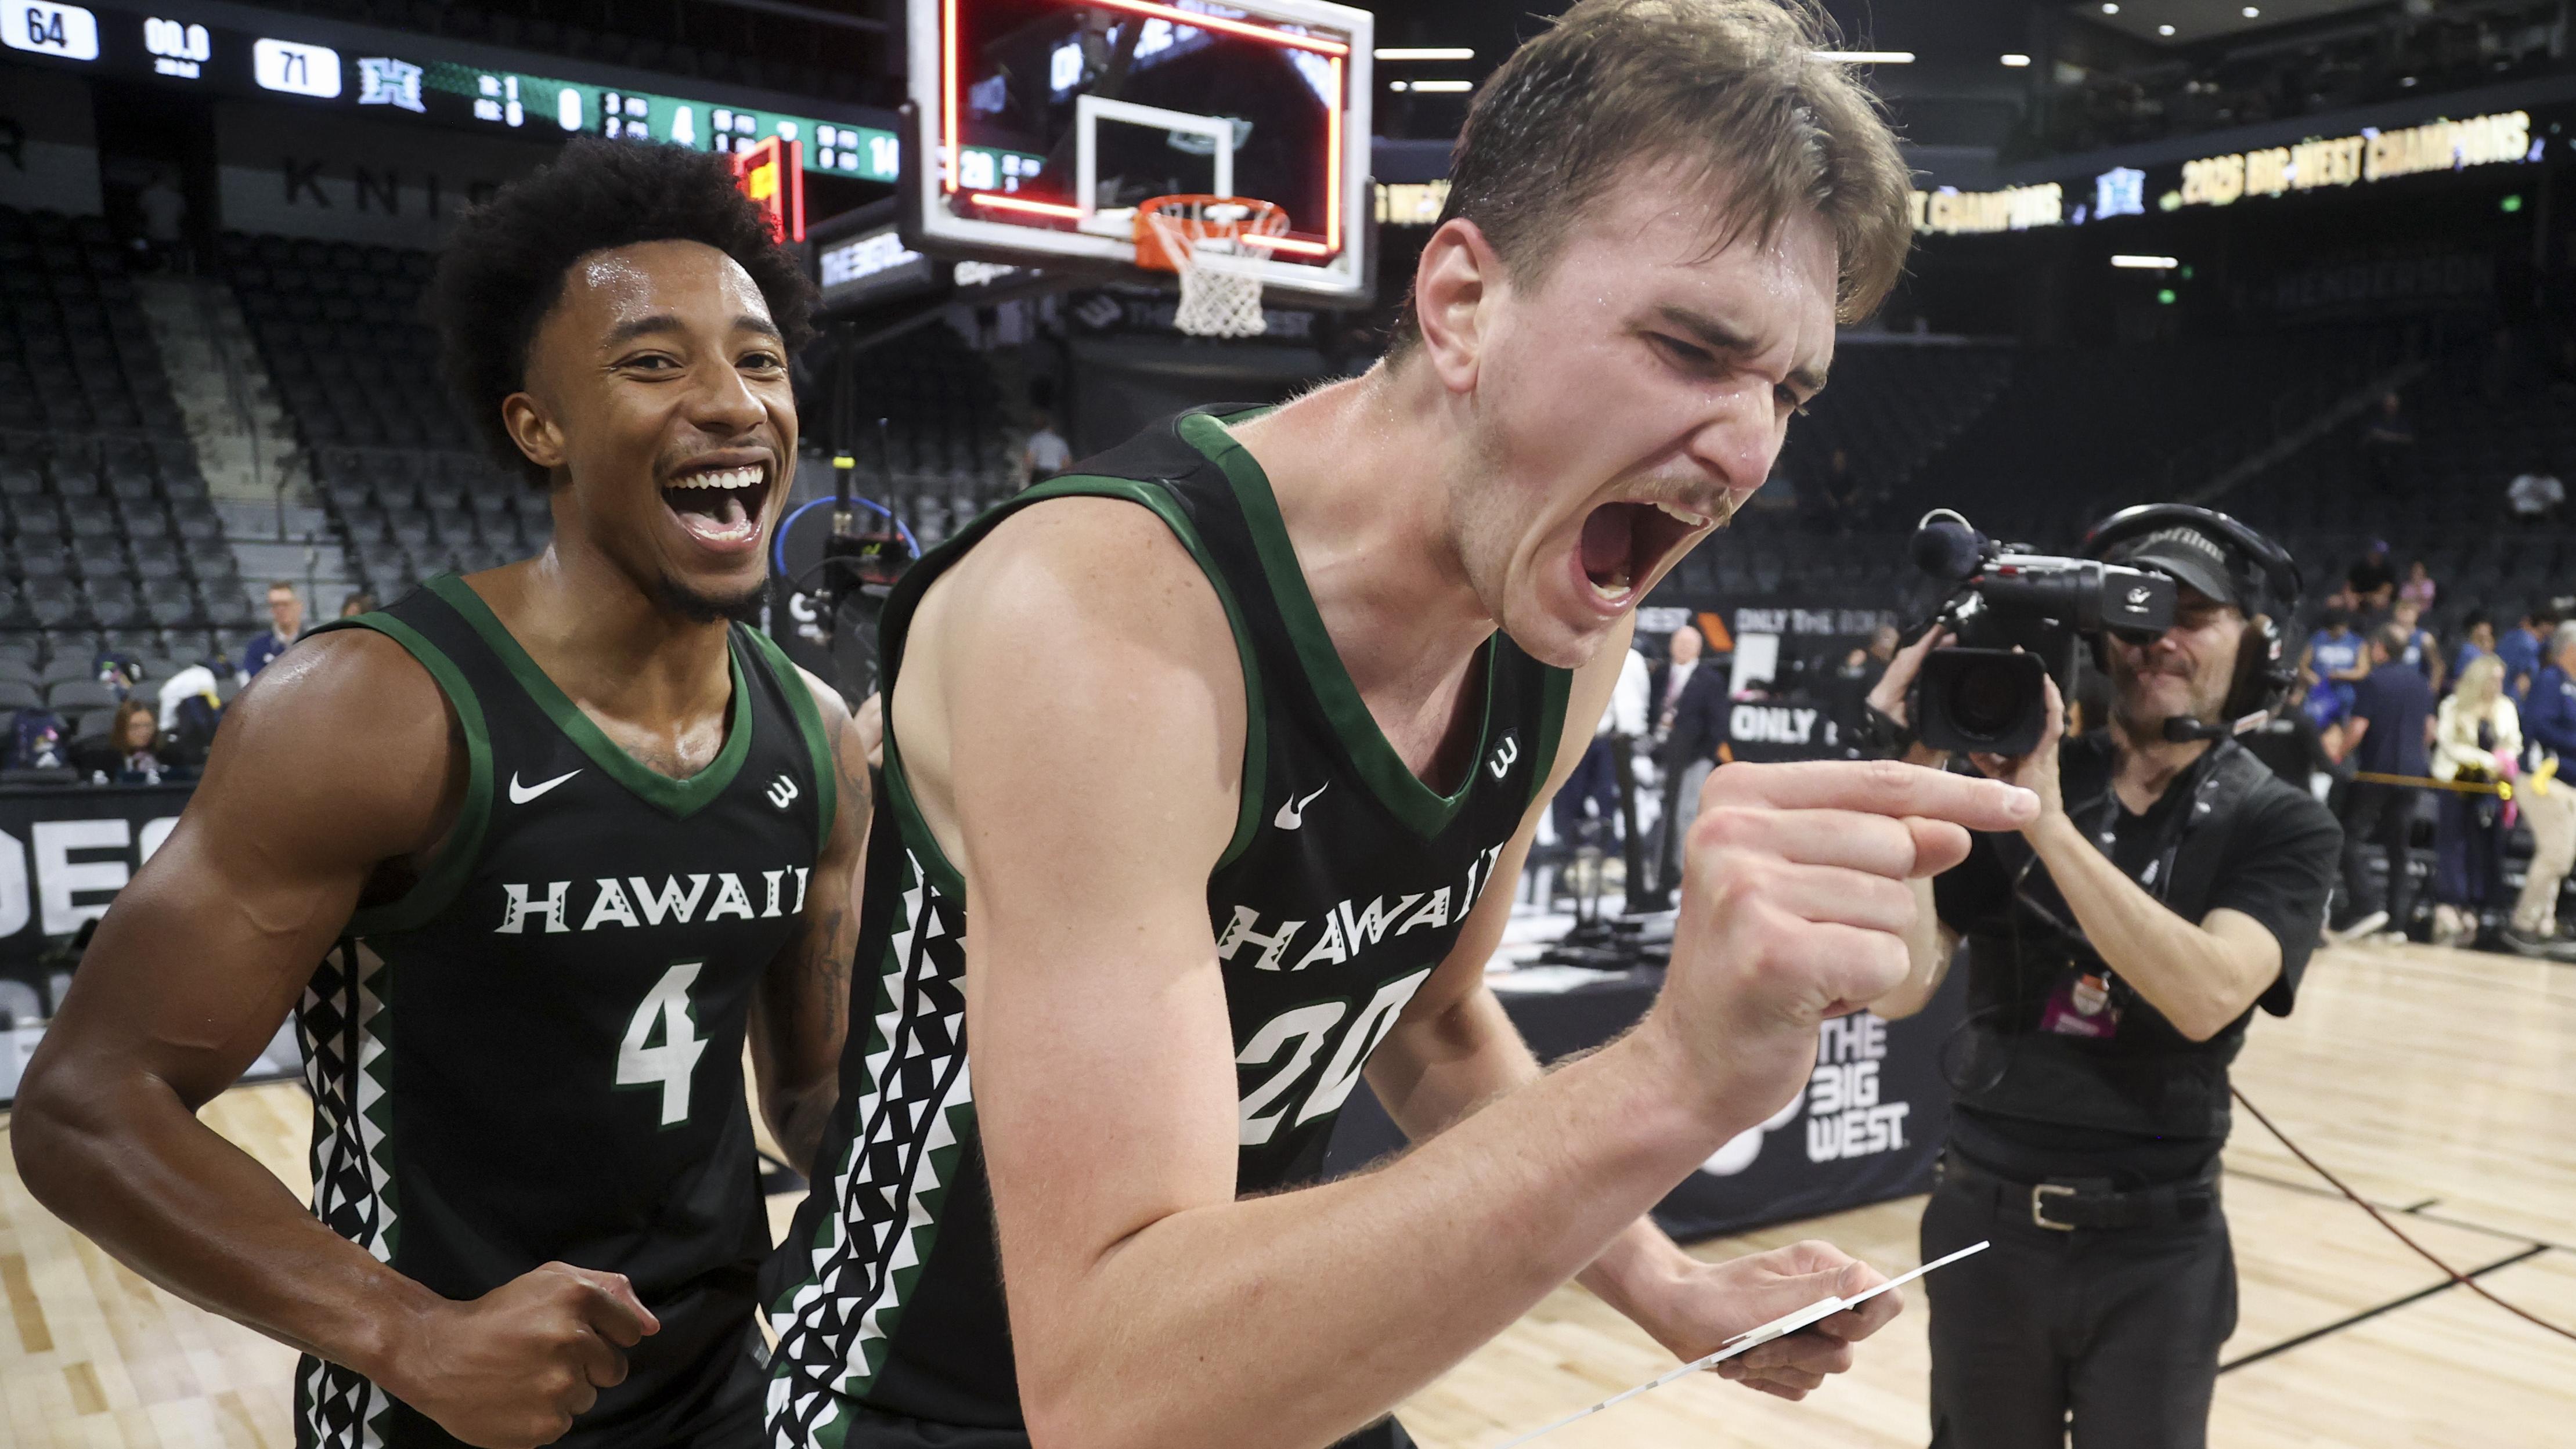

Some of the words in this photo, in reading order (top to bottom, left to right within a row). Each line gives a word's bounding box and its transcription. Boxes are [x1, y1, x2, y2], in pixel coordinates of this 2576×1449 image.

[27, 8, 67, 48] 64
[280, 50, 309, 87] 71
[1730, 704, 1817, 745] ONLY
[614, 960, 711, 1128] 4
[1235, 968, 1431, 1147] 20
[1817, 1014, 1887, 1064] THE
[1808, 1060, 1881, 1115] BIG
[1806, 1101, 1910, 1163] WEST
